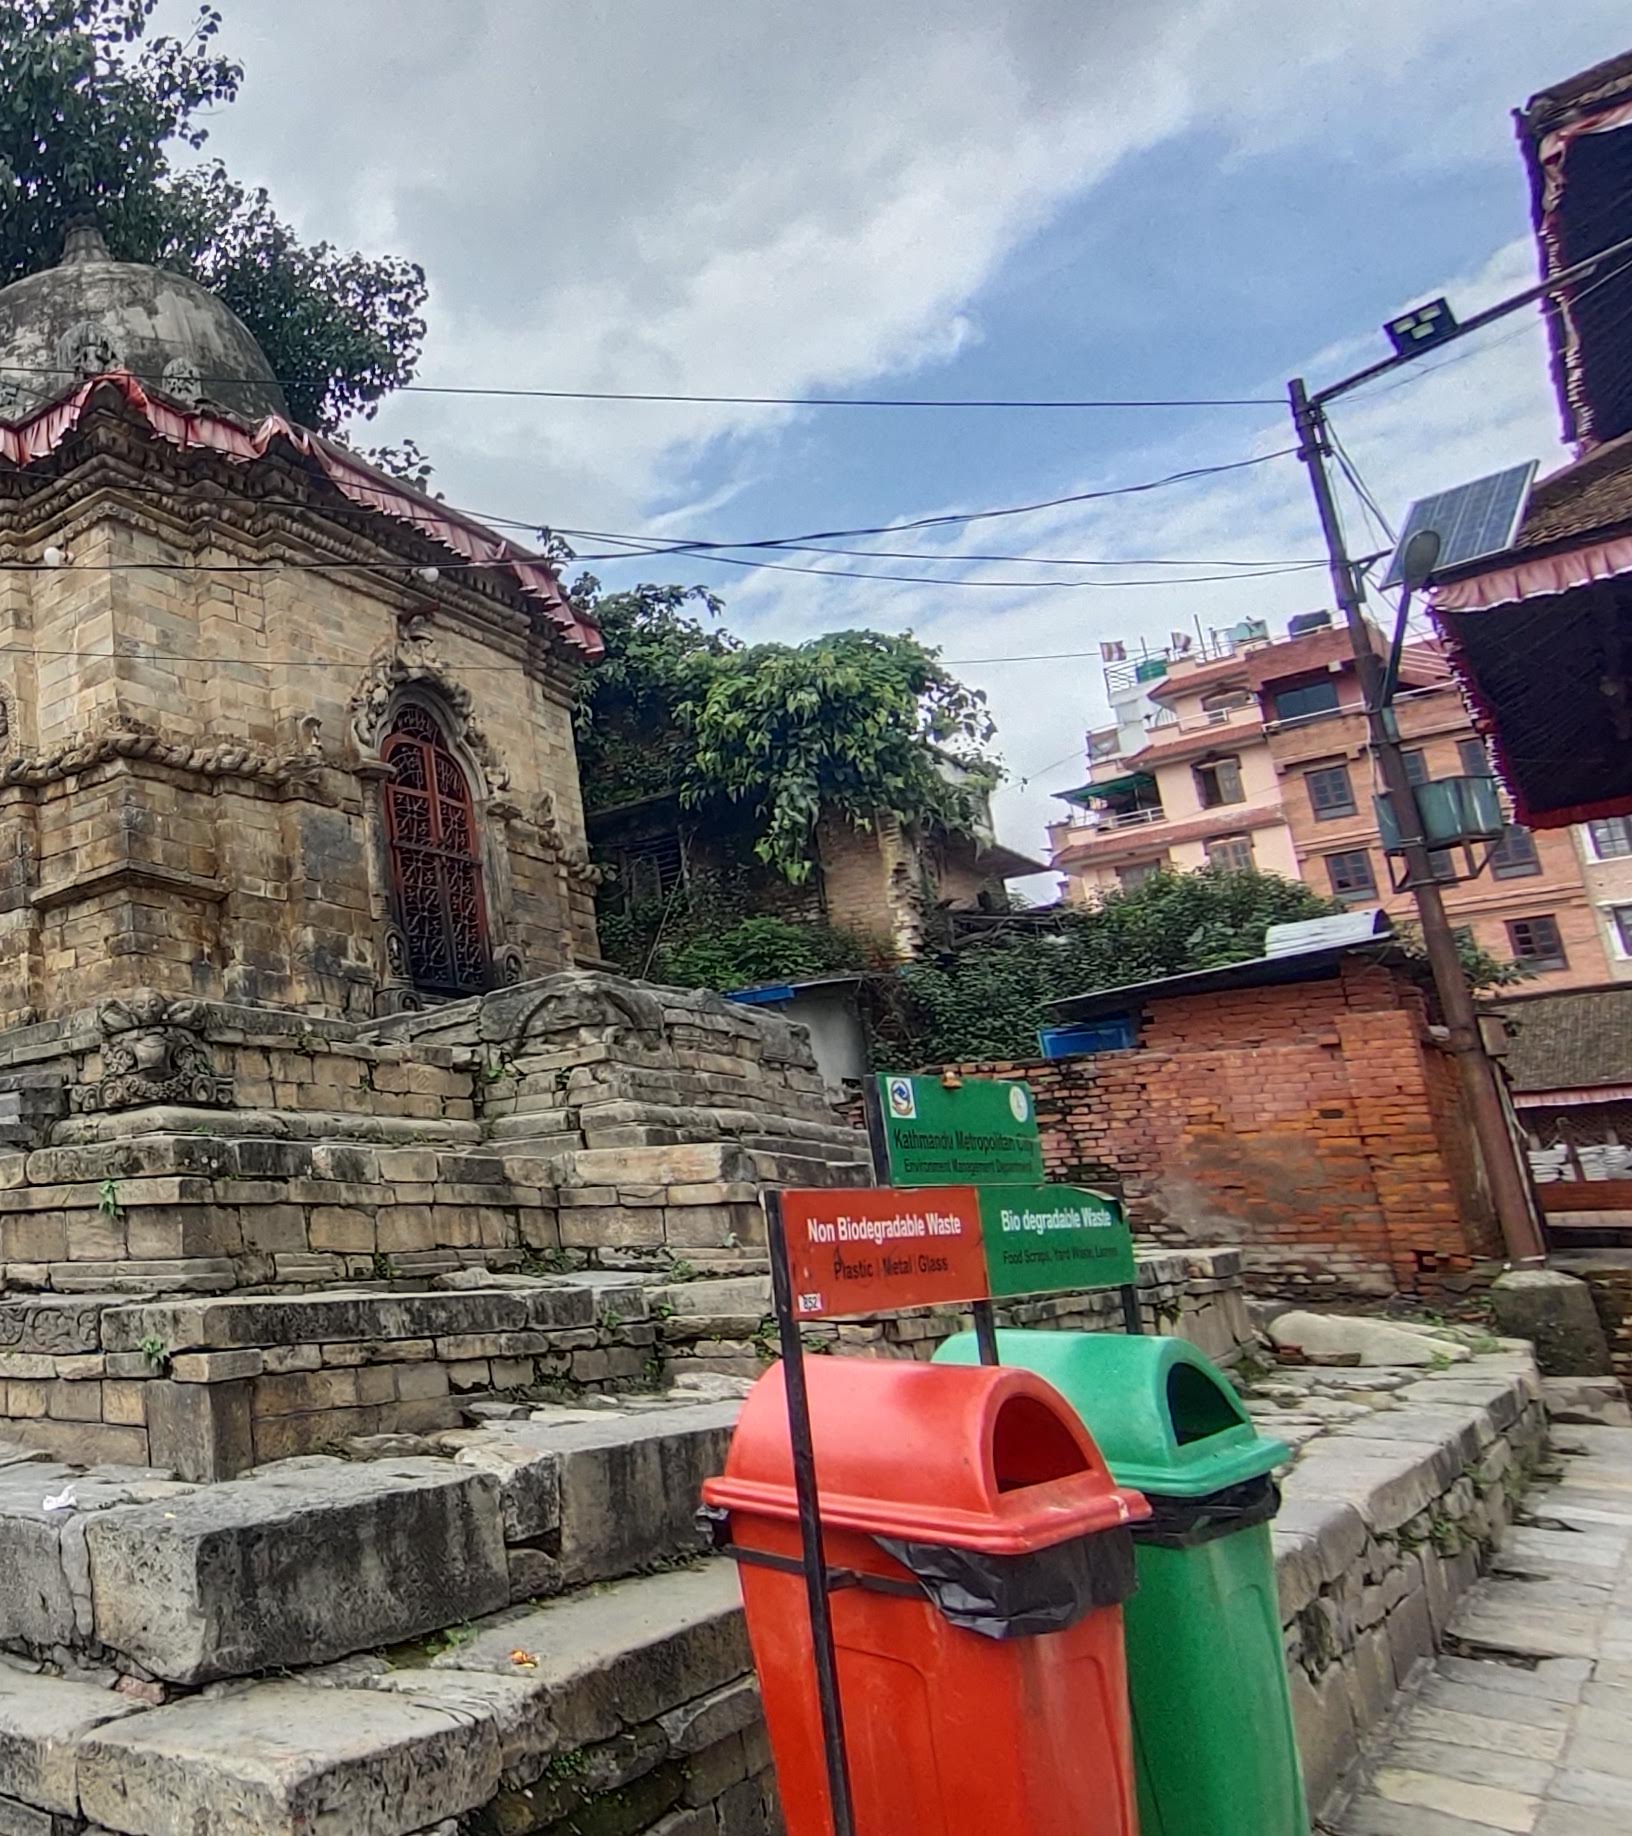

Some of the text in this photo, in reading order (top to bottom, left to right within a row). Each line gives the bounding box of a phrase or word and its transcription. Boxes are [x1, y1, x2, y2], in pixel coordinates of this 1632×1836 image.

[894, 1128, 953, 1150] Kathmandu
[956, 1130, 1014, 1155] Metropolitan
[807, 1212, 962, 1245] Non Biodegradable Waste
[1000, 1207, 1112, 1236] Bio degradable Waste
[834, 1254, 948, 1281] Plastic Metal Glass
[1003, 1249, 1023, 1265] Food
